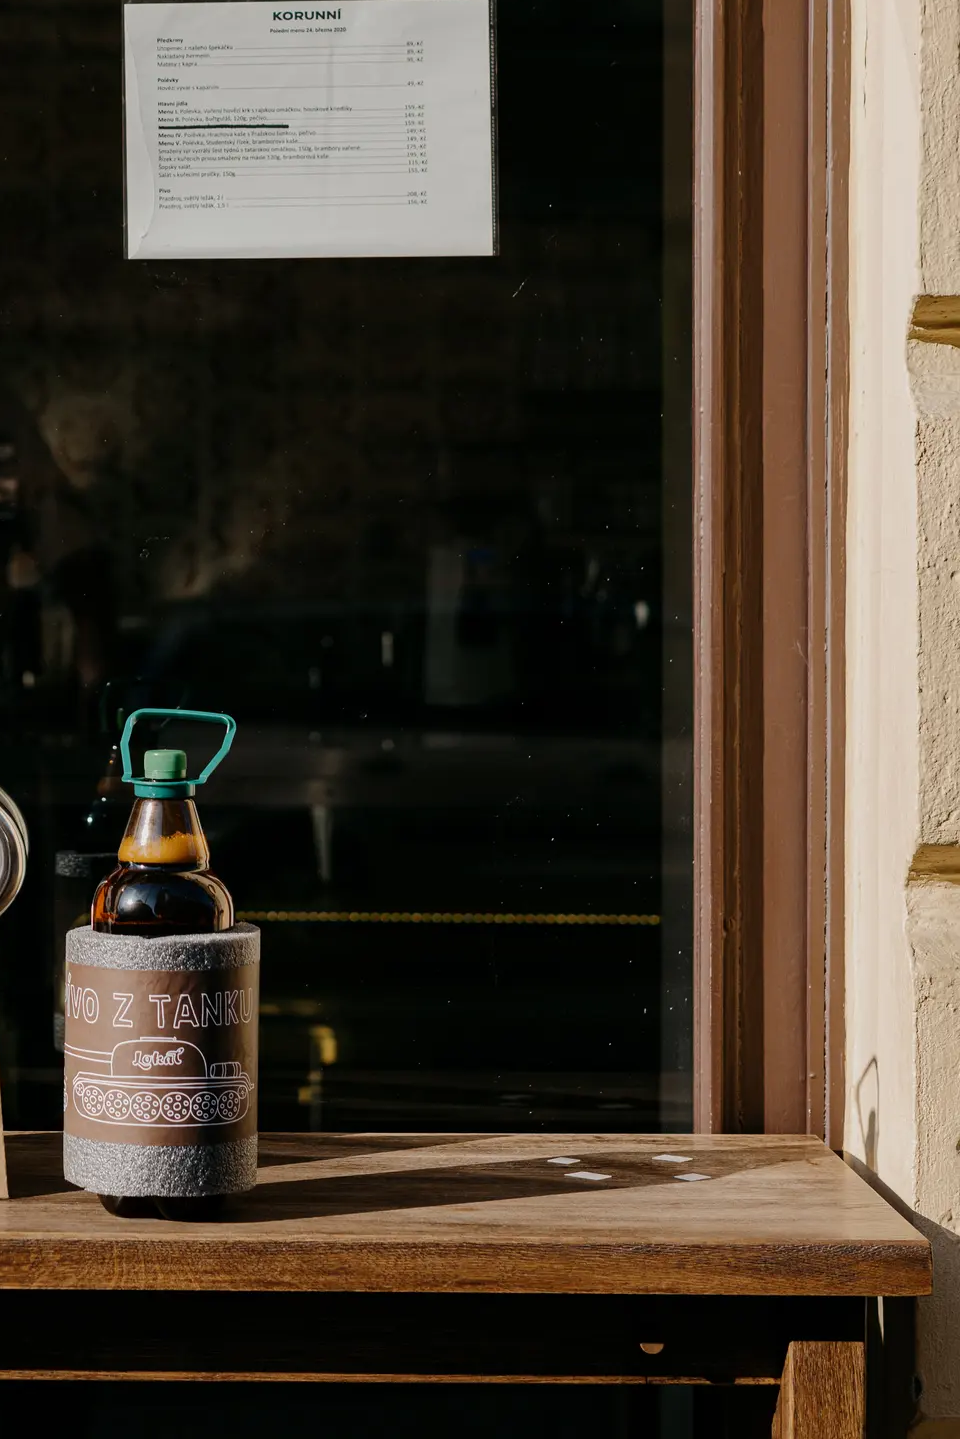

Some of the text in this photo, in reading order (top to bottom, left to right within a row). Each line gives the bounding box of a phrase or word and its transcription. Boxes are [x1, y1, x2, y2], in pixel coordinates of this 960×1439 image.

[272, 8, 342, 21] KORUNNÍ
[112, 992, 134, 1028] Z
[148, 987, 254, 1030] TANKU
